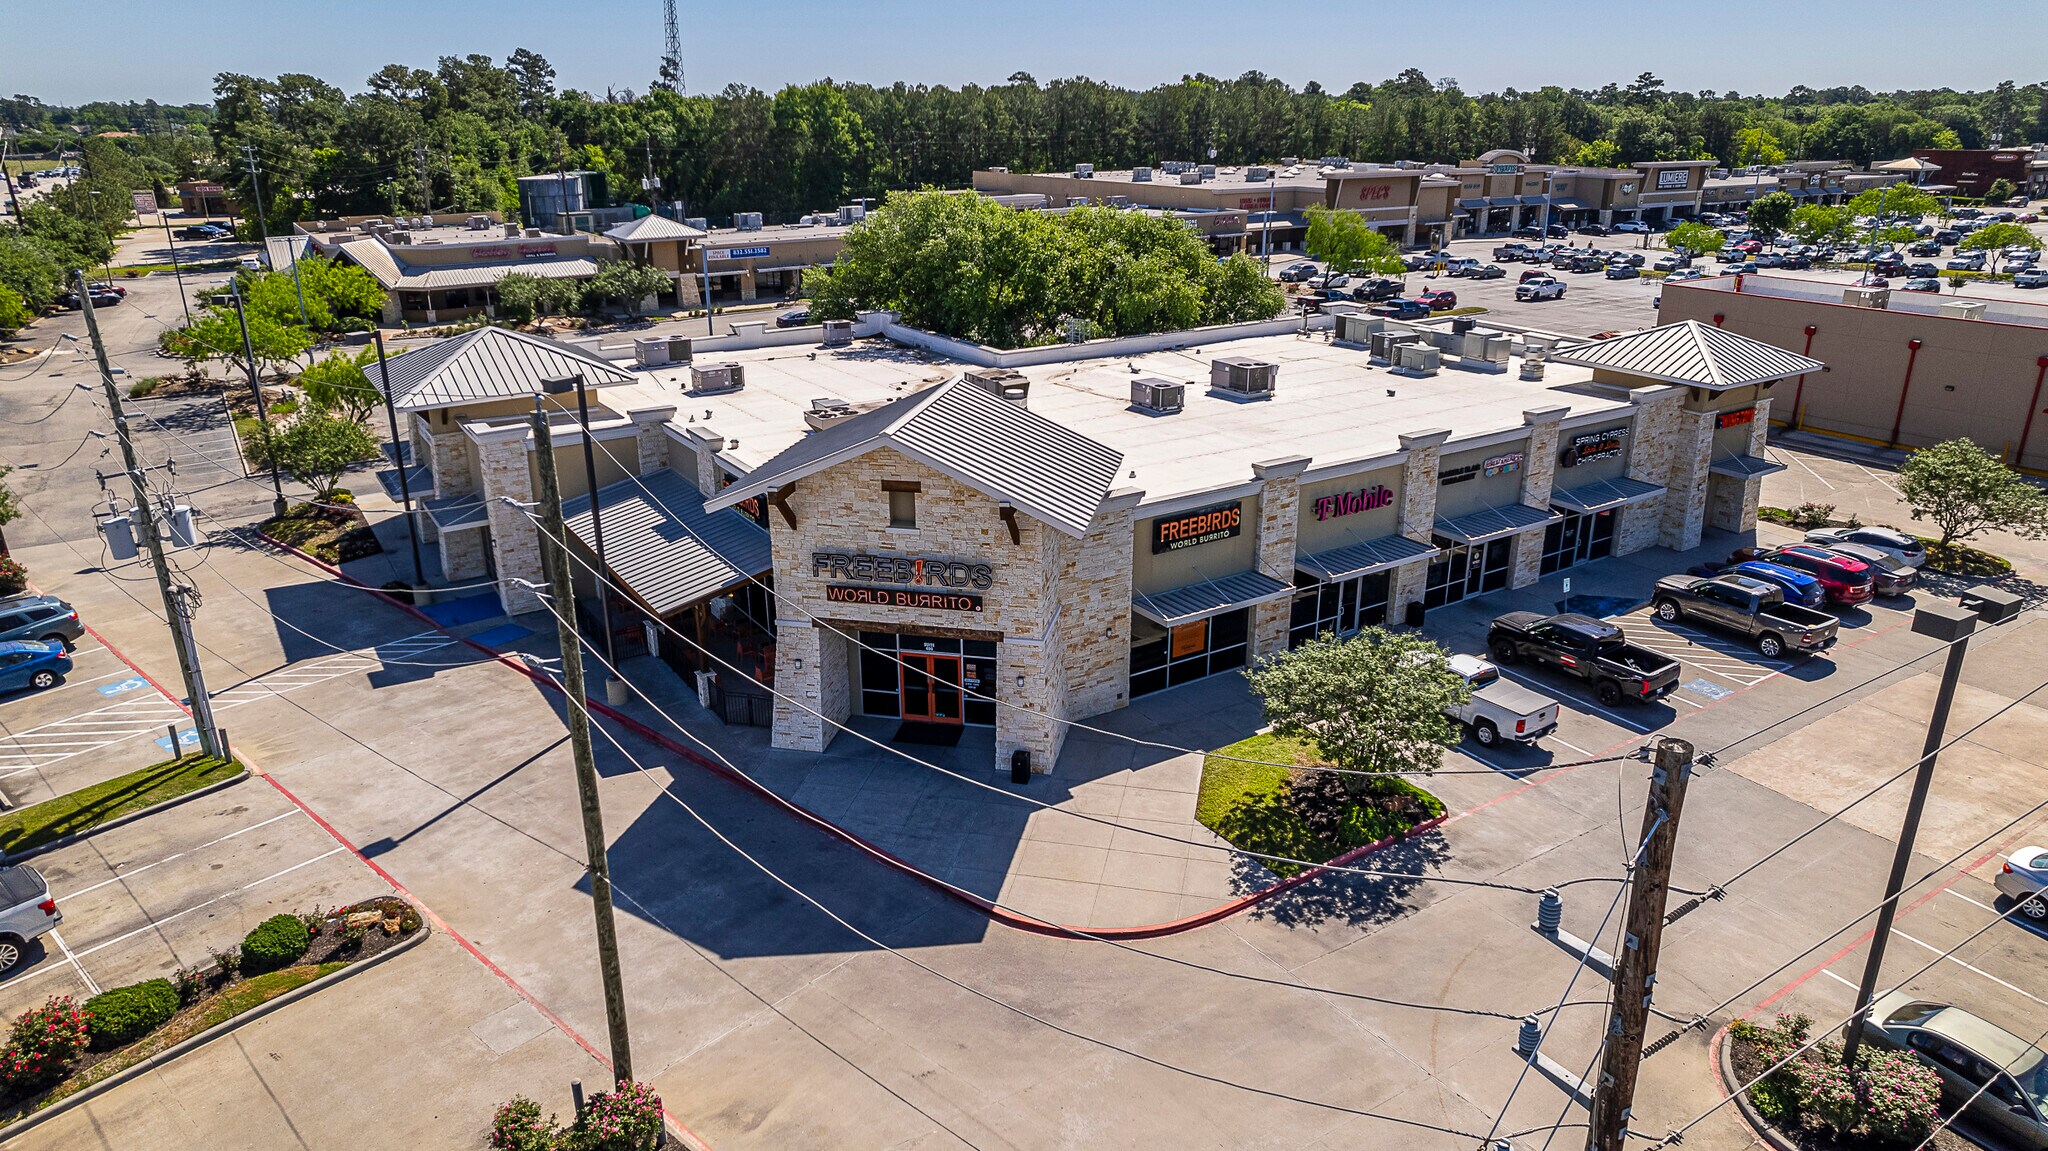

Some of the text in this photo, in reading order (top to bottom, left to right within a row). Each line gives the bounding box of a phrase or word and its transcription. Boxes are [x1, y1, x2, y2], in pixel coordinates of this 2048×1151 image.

[1575, 427, 1630, 447] SPRING CYPRESS
[1170, 529, 1230, 550] WORLD BURRITO
[828, 588, 972, 611] WORLD BURRITO
